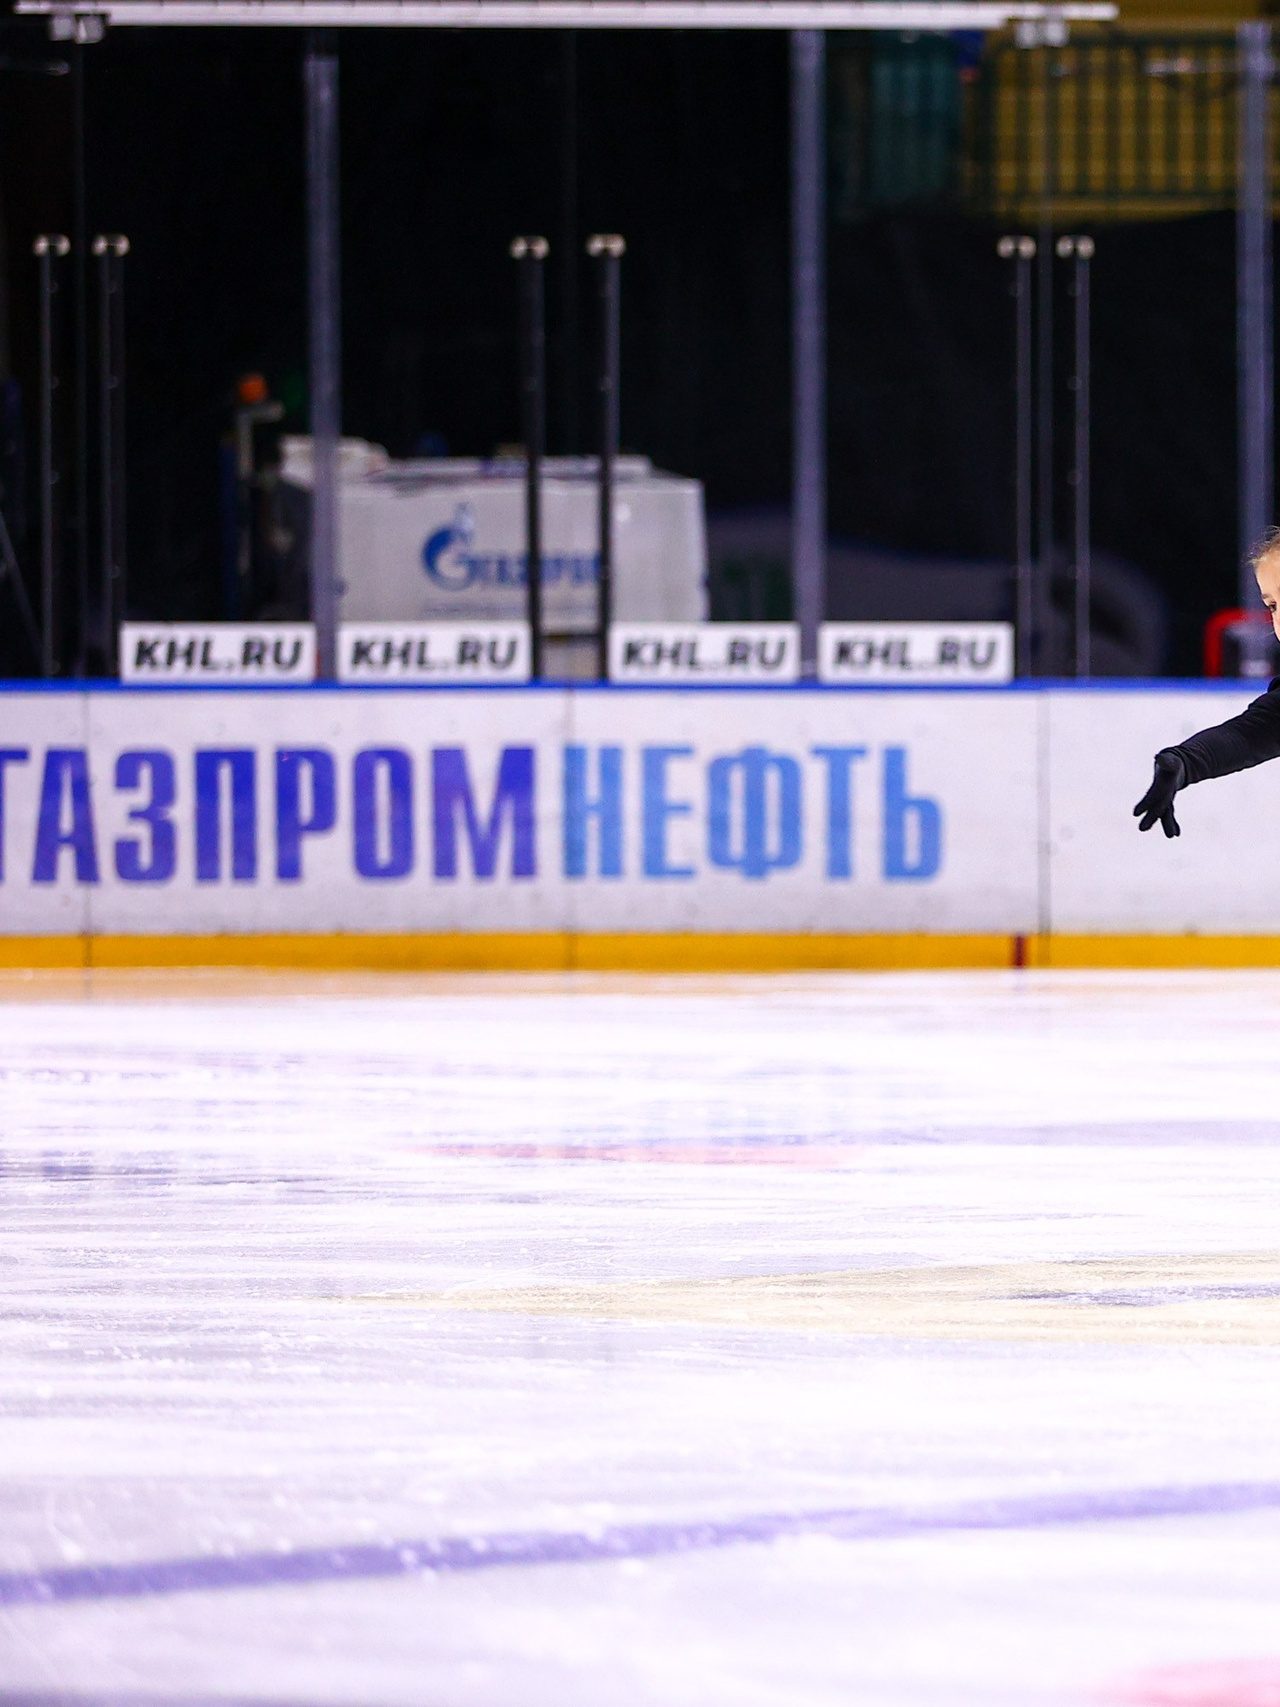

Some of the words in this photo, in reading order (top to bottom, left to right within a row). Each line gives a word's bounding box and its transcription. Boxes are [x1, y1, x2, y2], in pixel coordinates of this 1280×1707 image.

[133, 637, 303, 671] KHL.RU
[349, 637, 518, 671] KHL.RU
[621, 637, 787, 671] KHL.RU
[832, 637, 997, 671] KHL.RU
